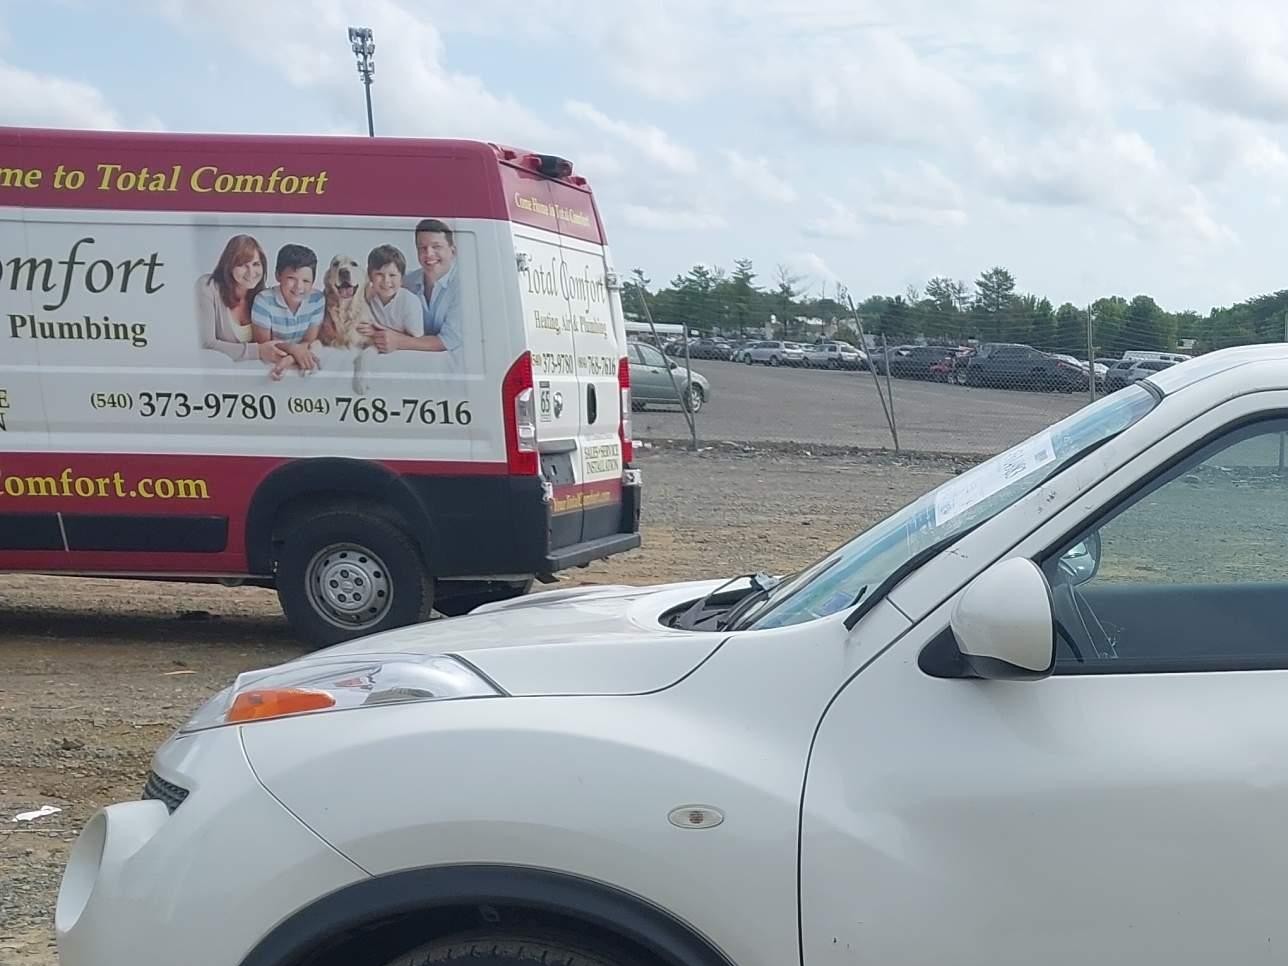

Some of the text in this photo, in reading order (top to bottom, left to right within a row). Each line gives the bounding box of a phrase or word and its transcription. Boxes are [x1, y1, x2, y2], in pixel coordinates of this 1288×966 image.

[53, 165, 85, 189] to
[97, 164, 182, 191] Total
[190, 166, 329, 195] Comfort
[0, 238, 165, 311] mfort
[8, 314, 148, 348] Plumbing
[90, 391, 472, 425] (540) 373-9780 (804) 768-7616
[0, 468, 210, 499] omfort.com
